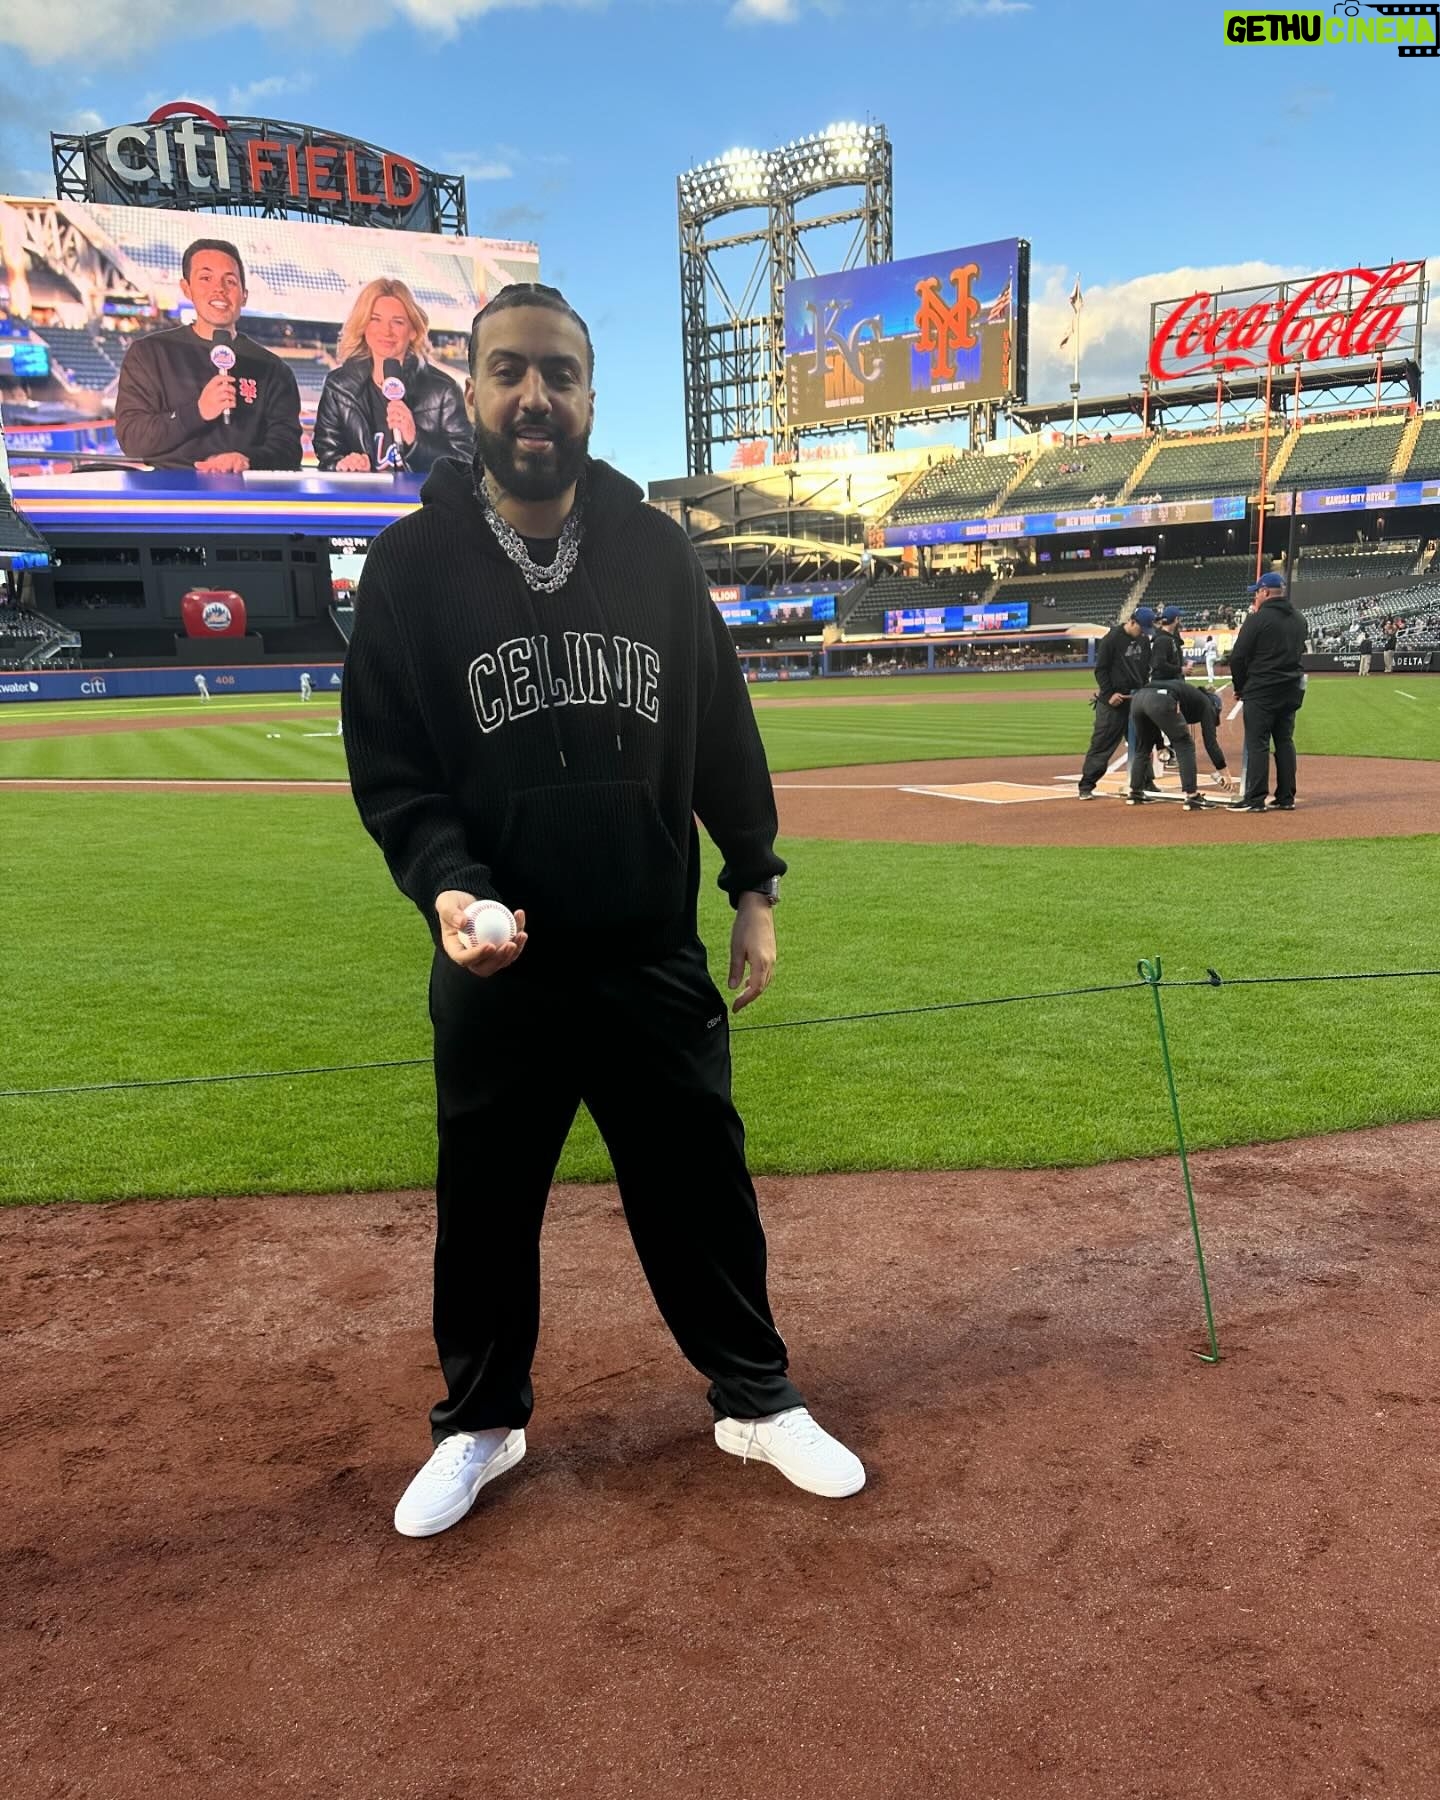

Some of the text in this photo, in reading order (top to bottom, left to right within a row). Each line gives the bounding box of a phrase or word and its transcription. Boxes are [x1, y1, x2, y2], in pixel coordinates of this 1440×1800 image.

[247, 139, 422, 207] FIELD
[1397, 657, 1423, 666] DELTA
[982, 664, 1025, 672] CADILLAC
[215, 675, 236, 685] 408
[468, 631, 660, 734] CELINE
